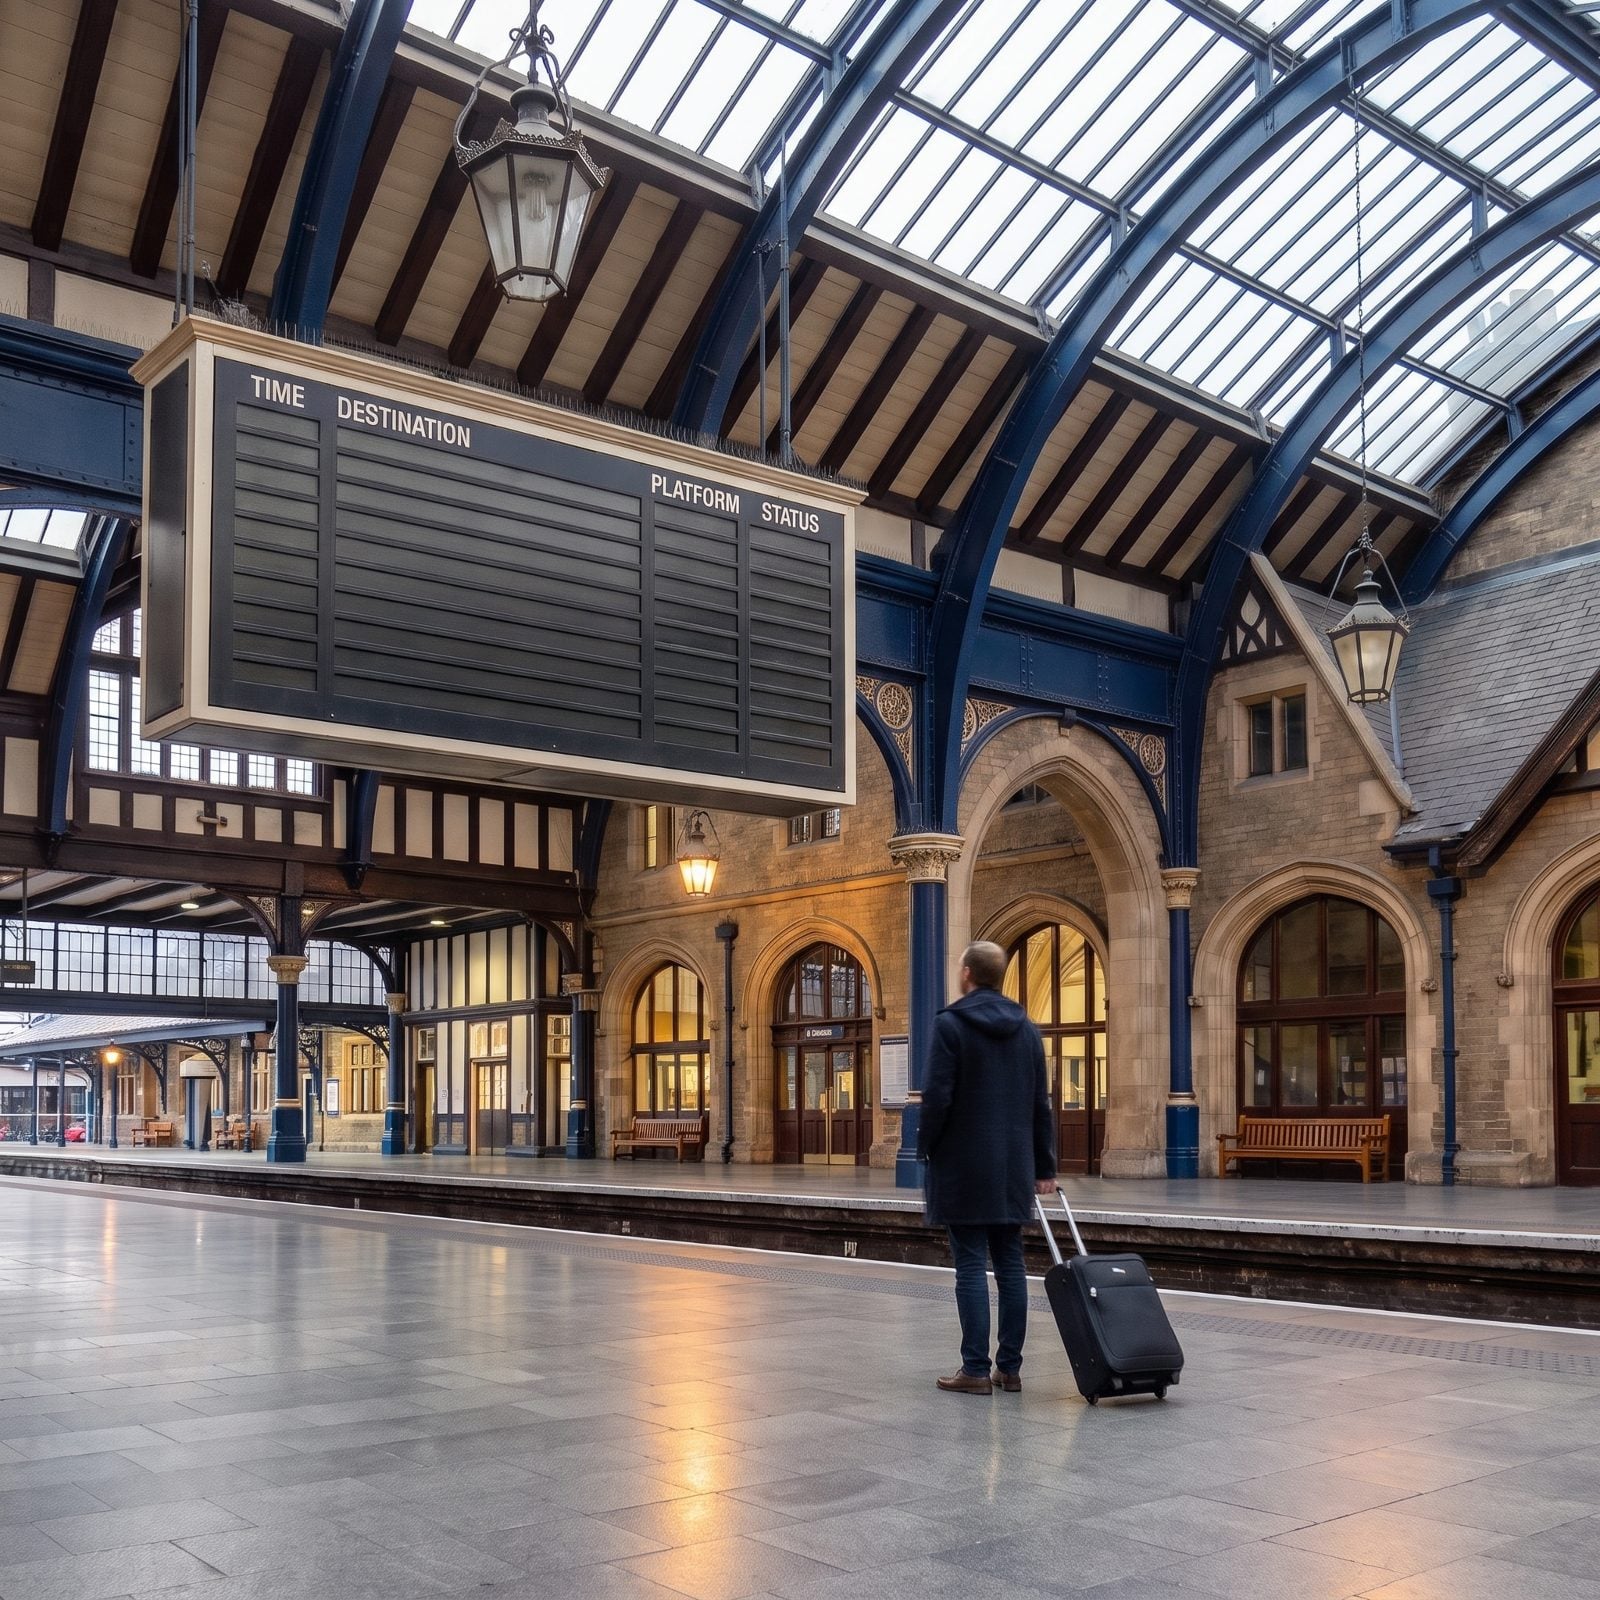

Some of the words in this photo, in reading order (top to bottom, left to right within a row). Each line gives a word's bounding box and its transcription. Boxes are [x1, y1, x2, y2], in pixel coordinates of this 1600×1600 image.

[251, 374, 305, 409] TIME
[337, 395, 472, 449] DESTINATION
[651, 473, 741, 514] PLATFORM
[761, 501, 821, 534] STATUS
